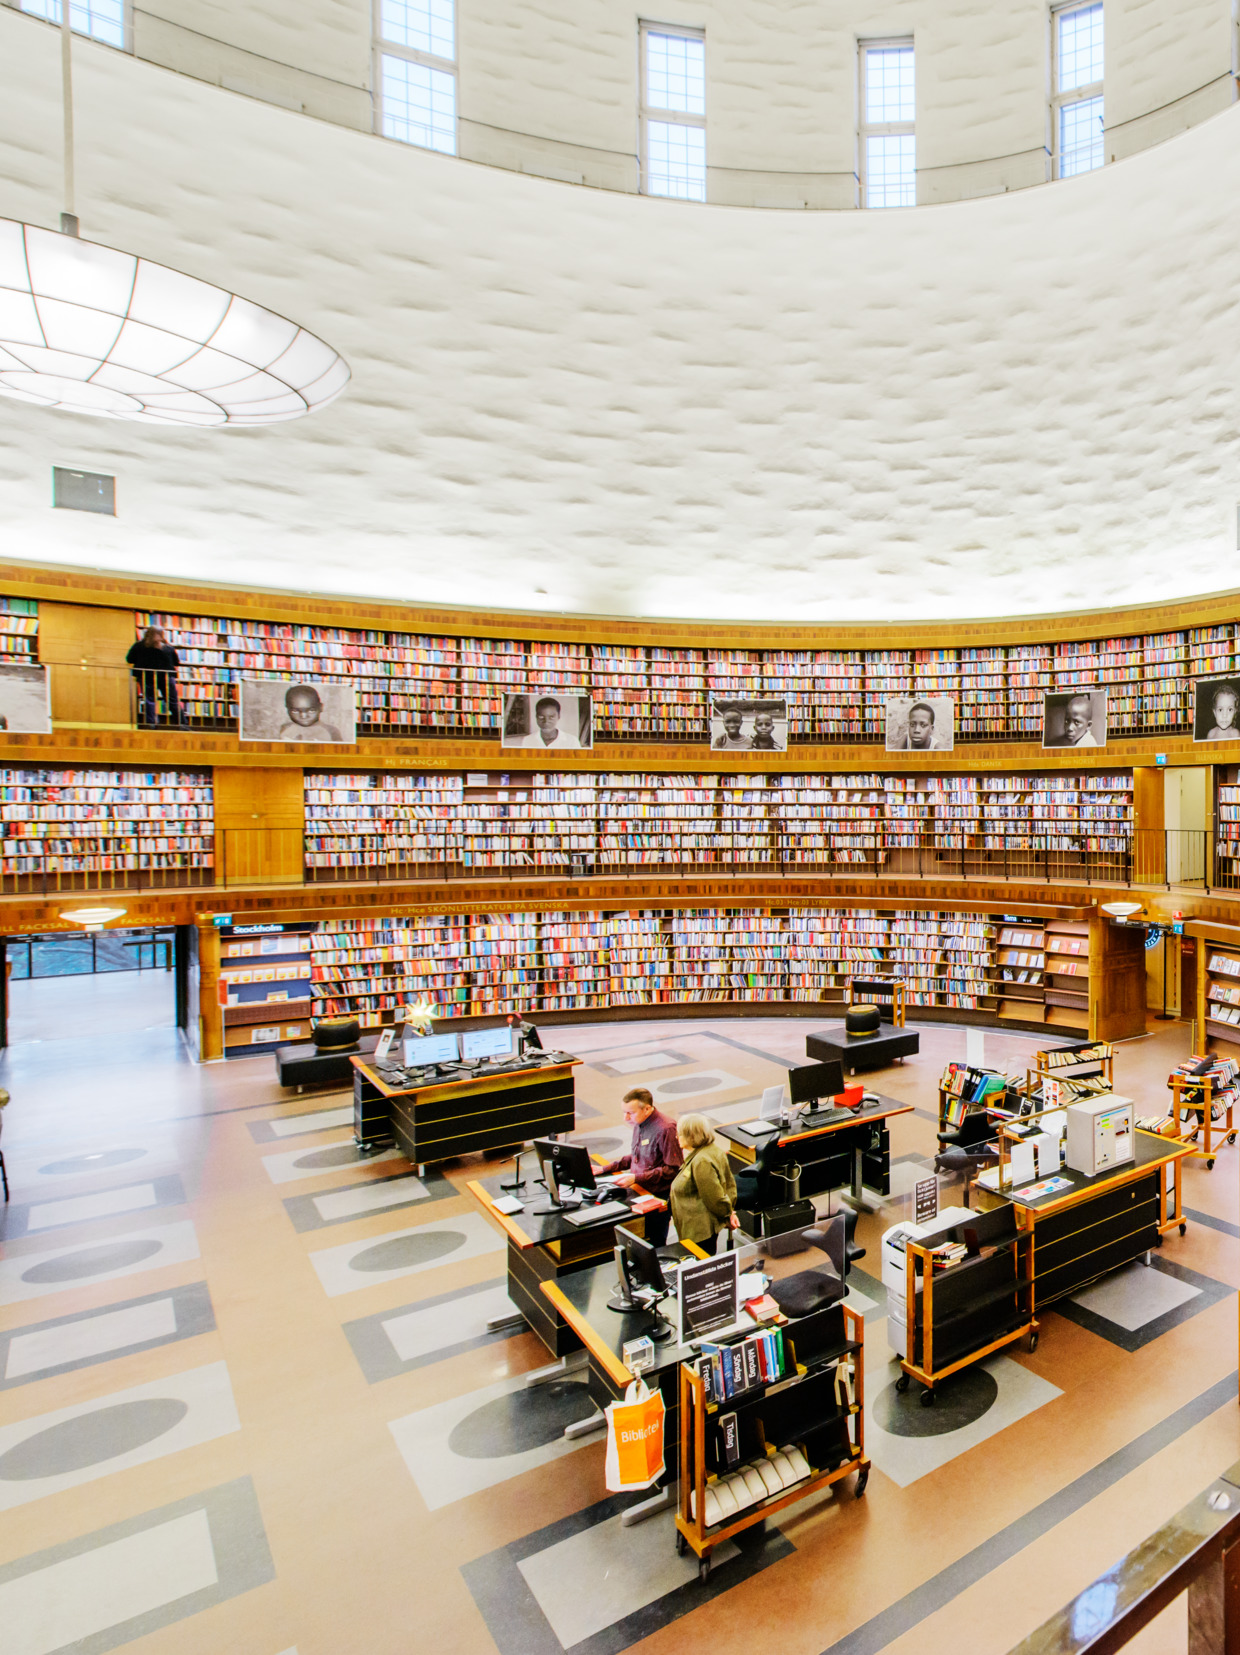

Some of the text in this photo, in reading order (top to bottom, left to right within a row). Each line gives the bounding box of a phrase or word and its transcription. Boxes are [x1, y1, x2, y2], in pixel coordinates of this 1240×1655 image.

[400, 758, 448, 767] FRANÇAIS
[427, 903, 511, 913] SKÖNLITTERATUR
[528, 901, 568, 910] SVENSKA
[19, 921, 69, 931] FACKSAL
[121, 917, 165, 925] FACKSAL
[233, 923, 284, 935] Stockholm
[717, 1260, 734, 1270] böcker
[733, 1353, 742, 1383] Söndag
[747, 1348, 756, 1378] Måndag
[703, 1364, 711, 1392] Fredag
[726, 1422, 735, 1449] Tisdag
